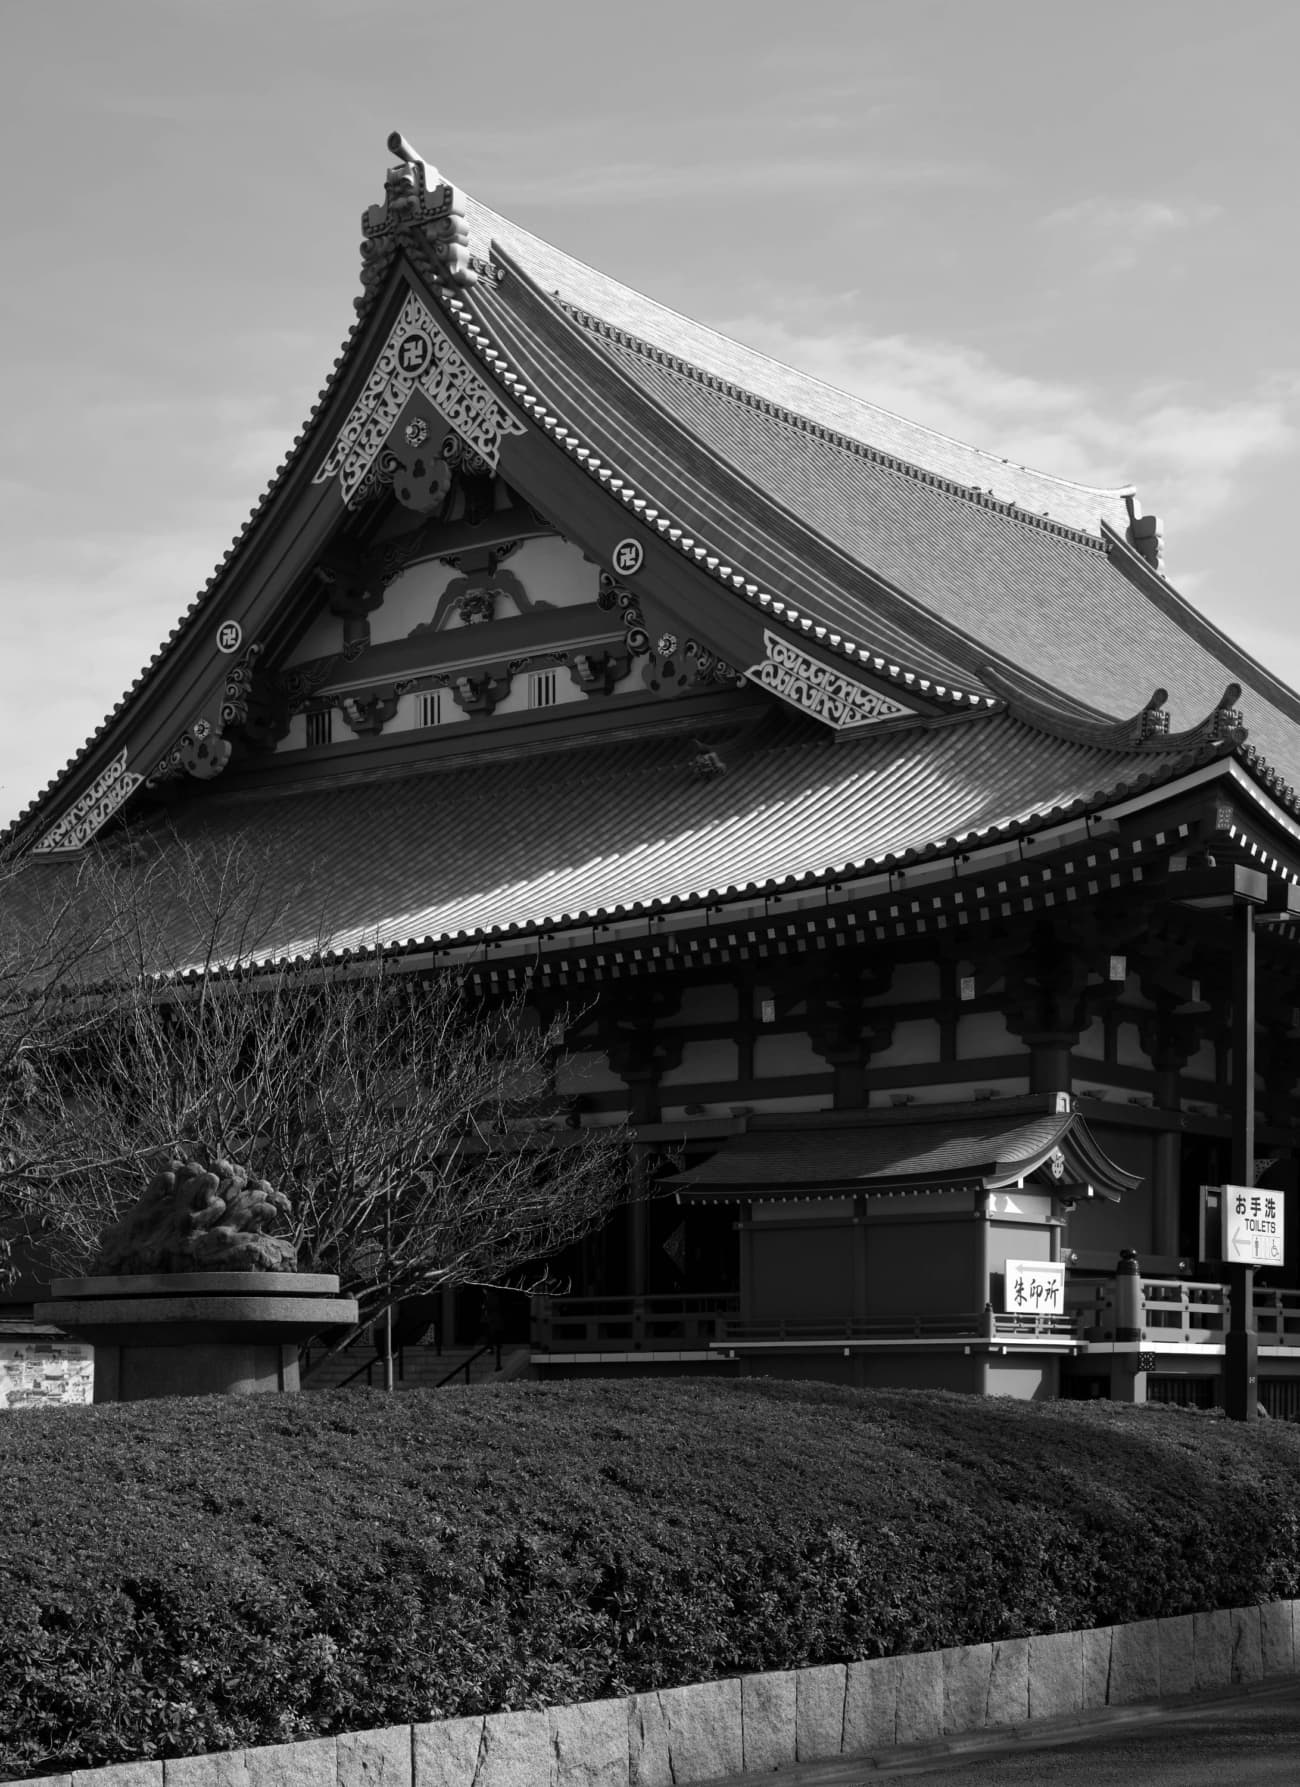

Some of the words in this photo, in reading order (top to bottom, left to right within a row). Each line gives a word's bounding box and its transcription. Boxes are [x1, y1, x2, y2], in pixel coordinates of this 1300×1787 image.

[1235, 1194, 1276, 1219] お手洗
[1244, 1218, 1276, 1233] TOILETS
[1014, 1276, 1060, 1309] 朱印所
